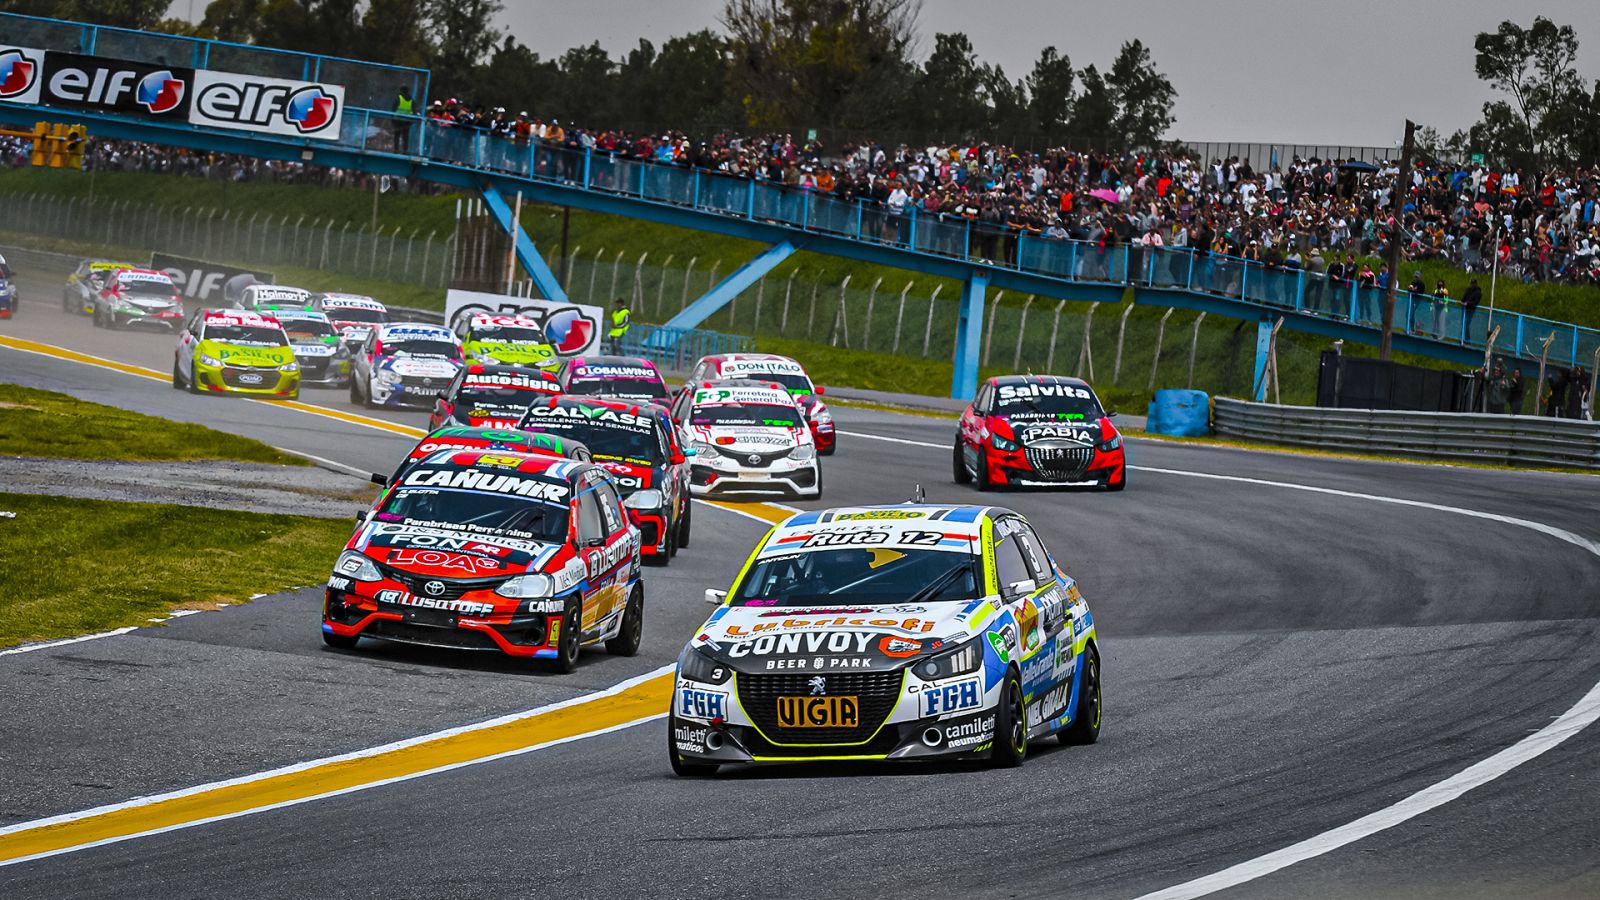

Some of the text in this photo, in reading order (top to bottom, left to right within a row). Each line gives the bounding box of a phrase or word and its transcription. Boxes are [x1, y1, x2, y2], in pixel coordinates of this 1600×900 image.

[50, 67, 136, 105] elf
[198, 82, 291, 126] elf
[323, 300, 384, 309] Forcam
[576, 366, 655, 377] GLOBALWING
[737, 362, 800, 372] DON ITALO
[465, 374, 561, 392] Autosiglo
[998, 384, 1091, 400] Salvita
[531, 405, 653, 428] CALVASE
[529, 417, 588, 425] EXCELENCIA
[605, 422, 651, 434] SEMILLAS
[404, 518, 466, 531] Parabrisas
[790, 524, 894, 537] EXPRESO
[801, 531, 944, 548] Ruta 12
[386, 549, 476, 573] LOA
[726, 617, 936, 636] Lubricofi
[729, 632, 876, 658] CONVOY
[766, 658, 872, 670] BEER PARK
[711, 668, 723, 679] 3
[677, 680, 697, 690] CAL
[907, 681, 942, 694] CAL
[682, 689, 725, 719] FGH
[924, 681, 979, 716] FGH
[779, 698, 857, 726] VIGIA
[946, 714, 996, 739] camiletti
